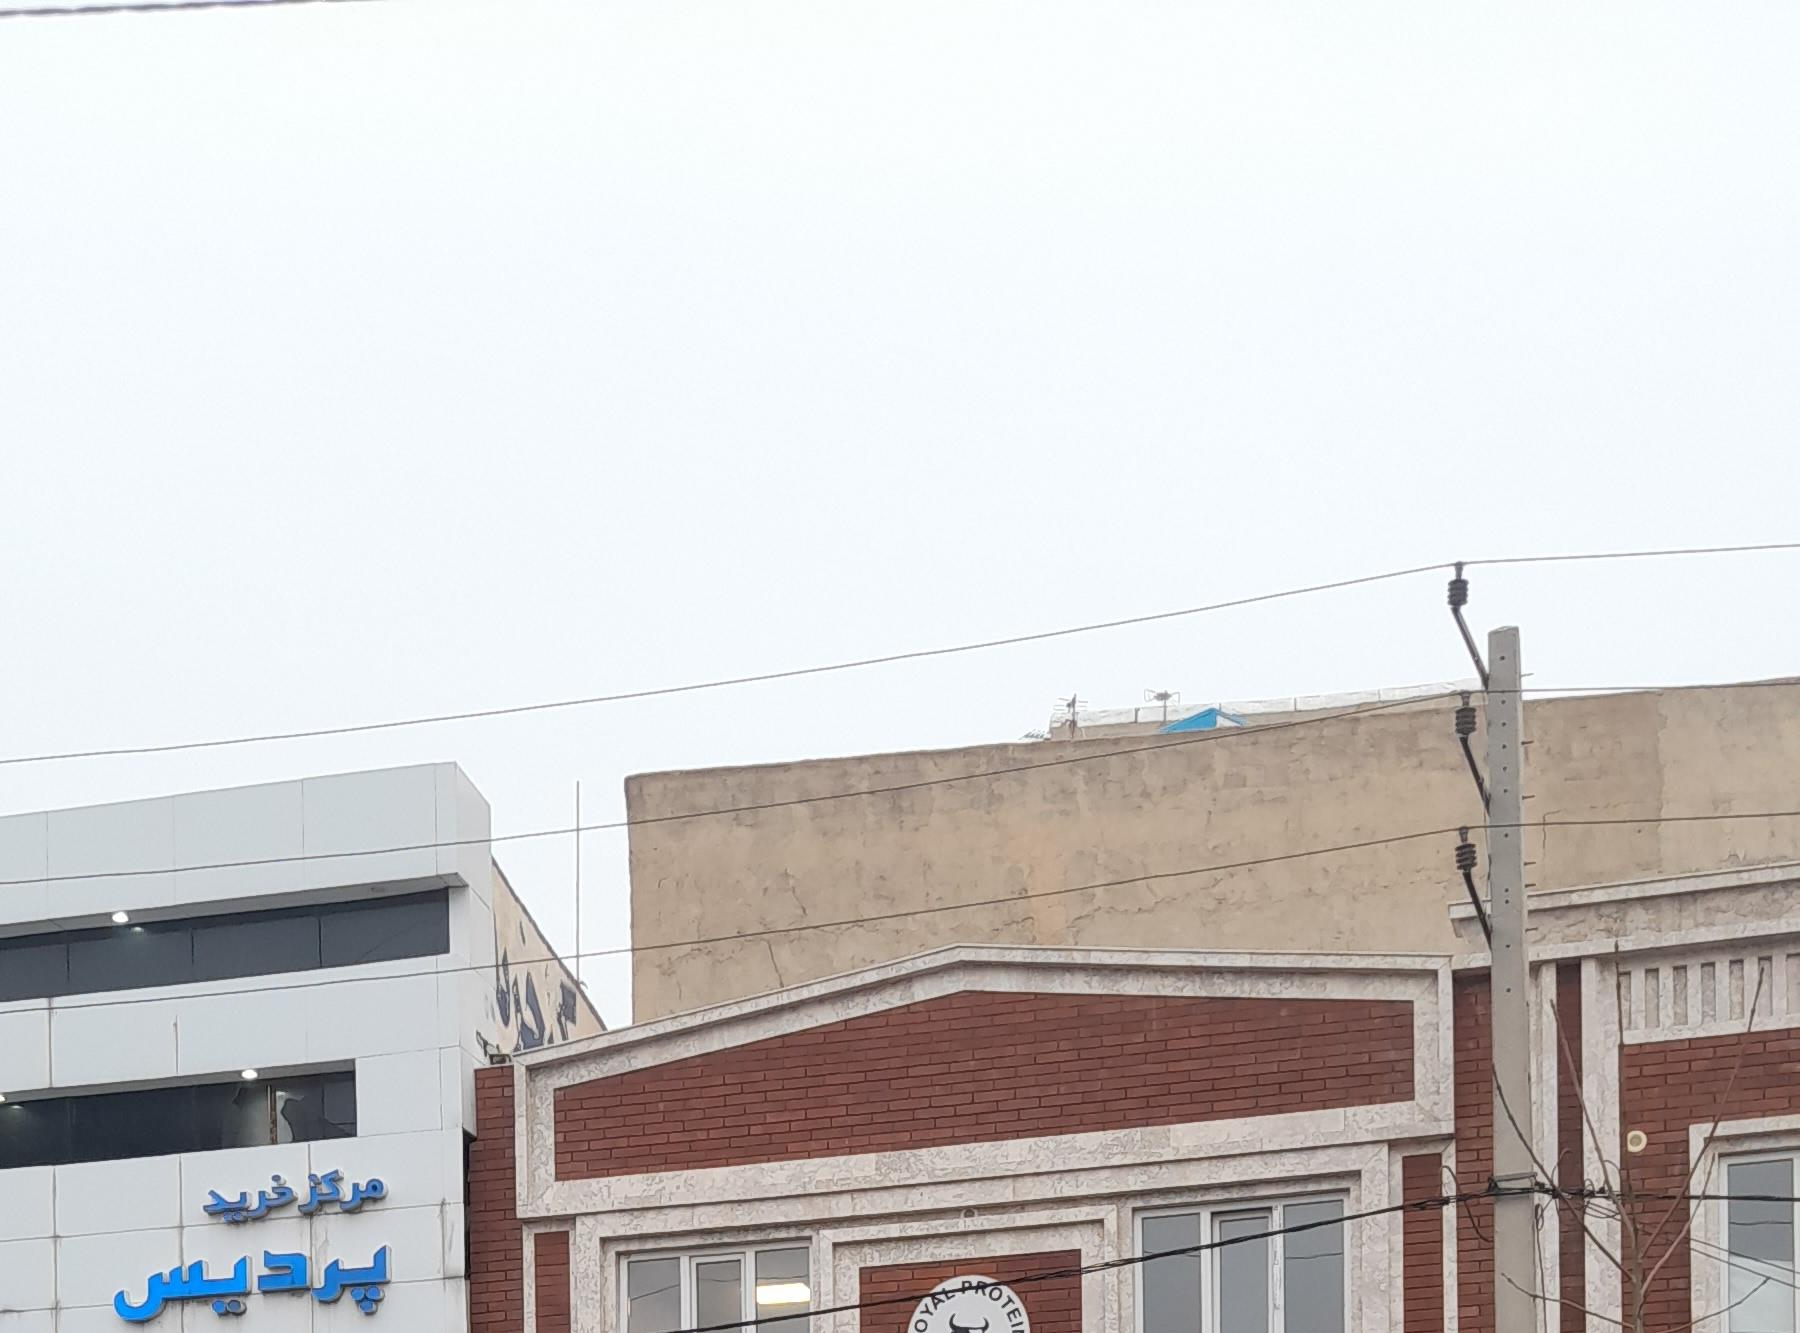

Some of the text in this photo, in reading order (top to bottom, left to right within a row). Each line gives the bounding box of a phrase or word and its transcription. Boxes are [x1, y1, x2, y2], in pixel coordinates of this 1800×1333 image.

[202, 1168, 389, 1224] مرکز خرید
[112, 1245, 392, 1323] پردیس
